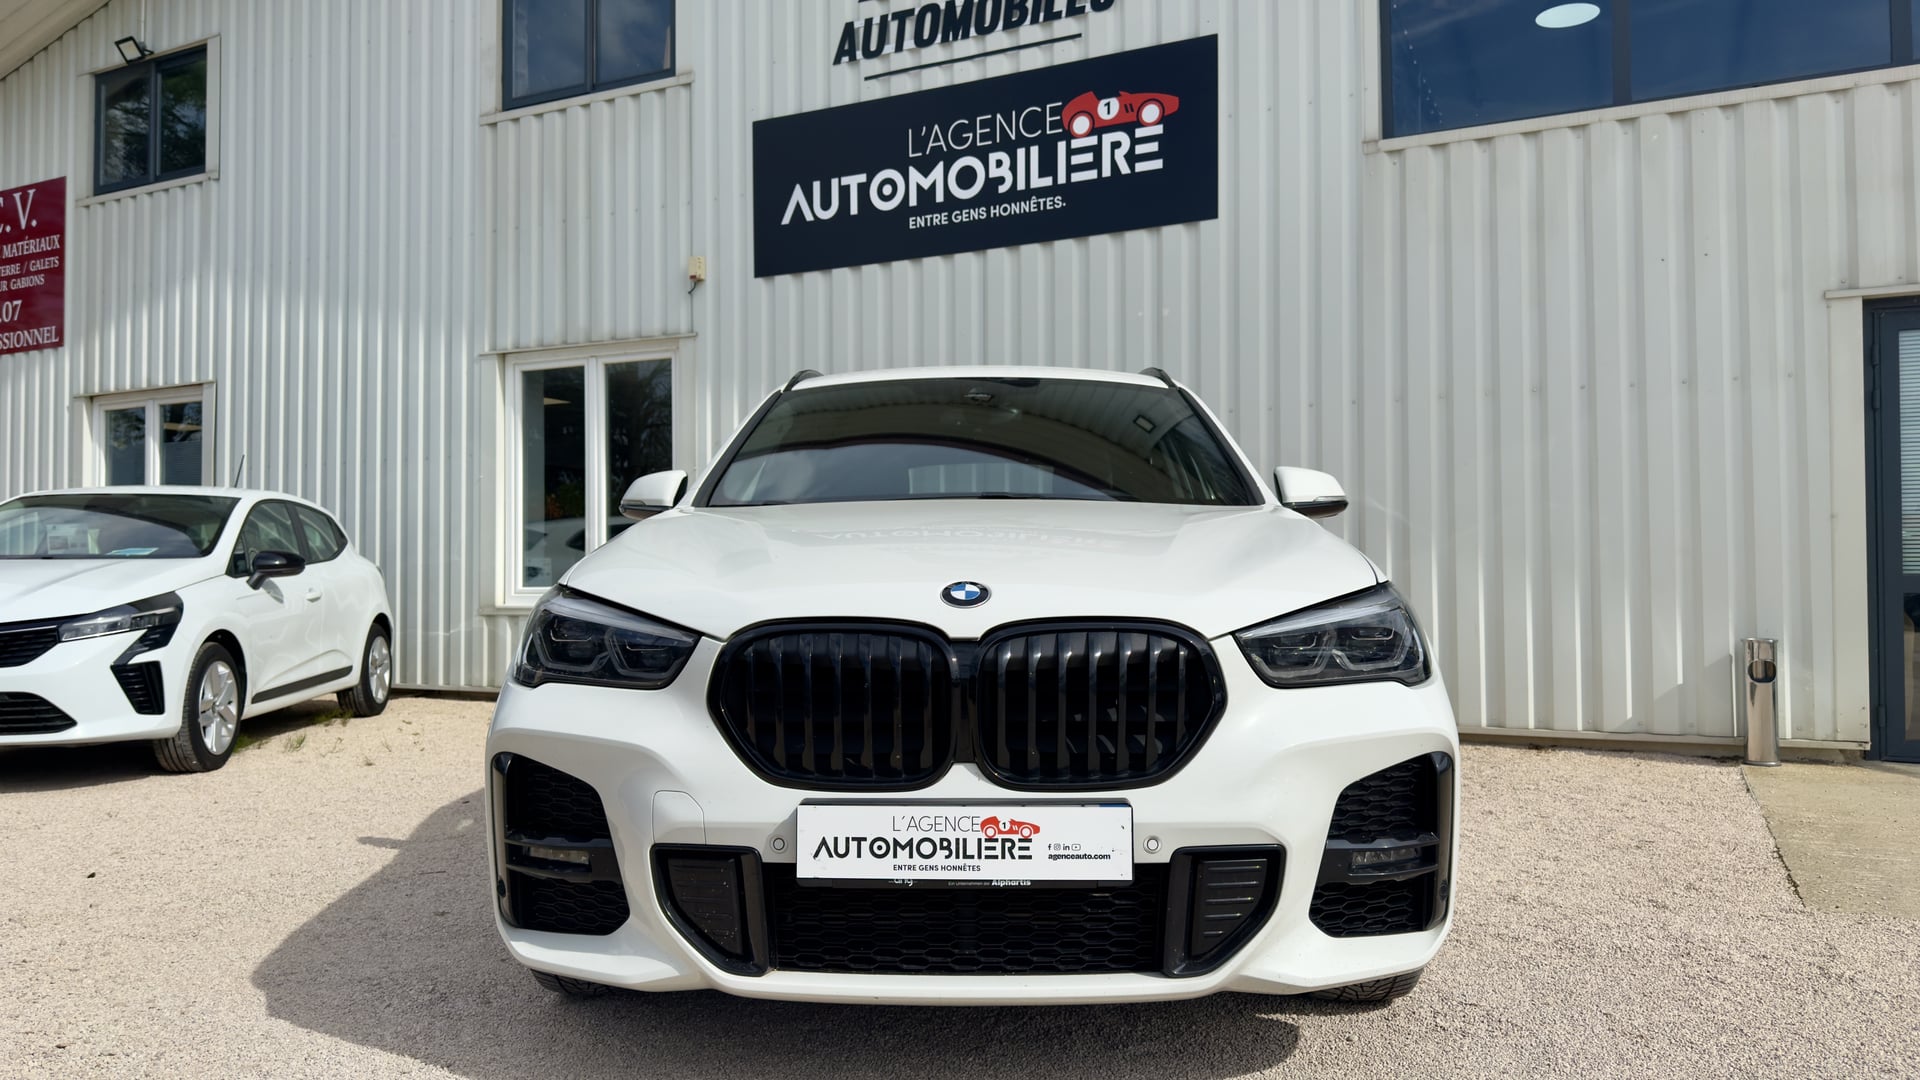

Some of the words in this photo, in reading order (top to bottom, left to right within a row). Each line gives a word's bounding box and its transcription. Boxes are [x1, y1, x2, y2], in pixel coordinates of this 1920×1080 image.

[833, 0, 1115, 65] AUTOMOBIL
[1104, 101, 1111, 115] 1
[908, 102, 1063, 157] L'AGENCE
[909, 212, 949, 229] ENTRE
[952, 207, 987, 223] GENS
[990, 195, 1066, 219] HONNÊTES.
[2, 234, 60, 259] MATÉRIAUX
[29, 256, 60, 272] GALETS
[10, 274, 45, 290] GABIONS
[892, 815, 981, 833] L'AGENCE
[1001, 821, 1007, 829] 1
[1047, 853, 1111, 861] agenceauto.com
[893, 864, 917, 872] ENTRE
[918, 864, 939, 872] GENS
[940, 862, 981, 872] HONNÊTES
